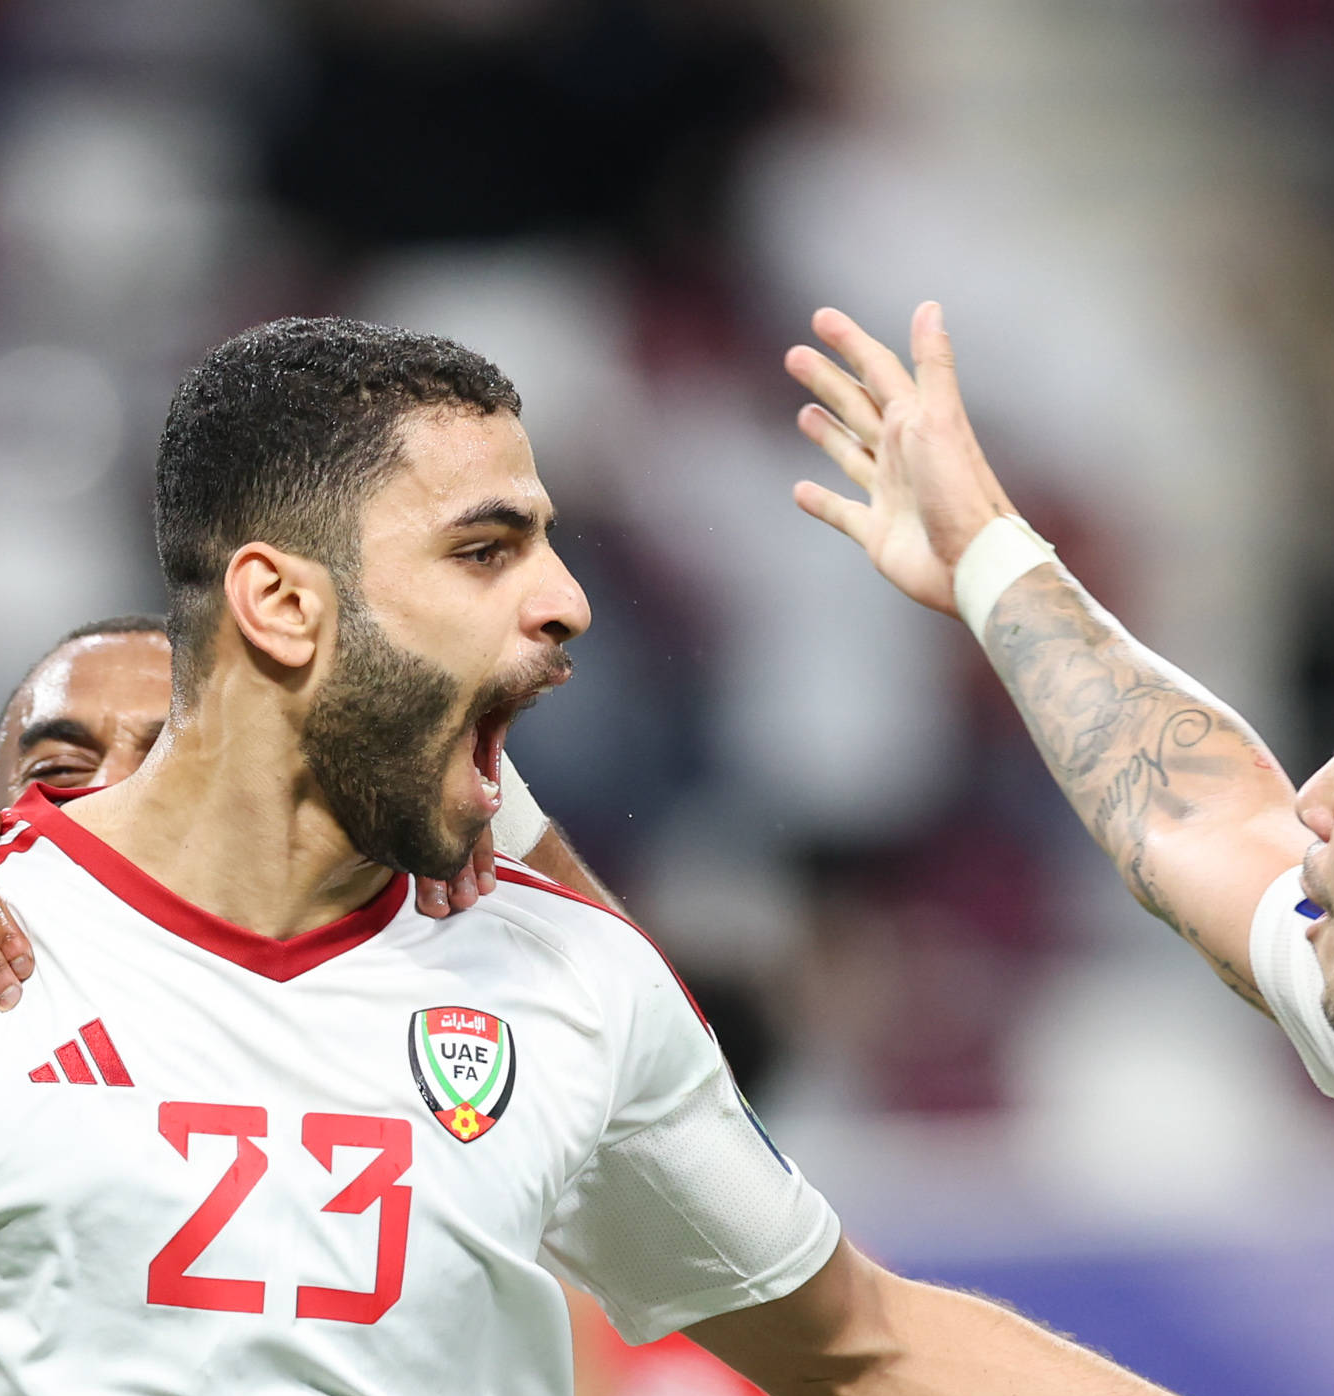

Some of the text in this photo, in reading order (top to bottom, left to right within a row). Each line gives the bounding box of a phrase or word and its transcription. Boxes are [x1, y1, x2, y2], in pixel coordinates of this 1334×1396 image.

[441, 1043, 488, 1064] UAE
[453, 1065, 479, 1081] FA
[147, 1101, 412, 1325] 23
